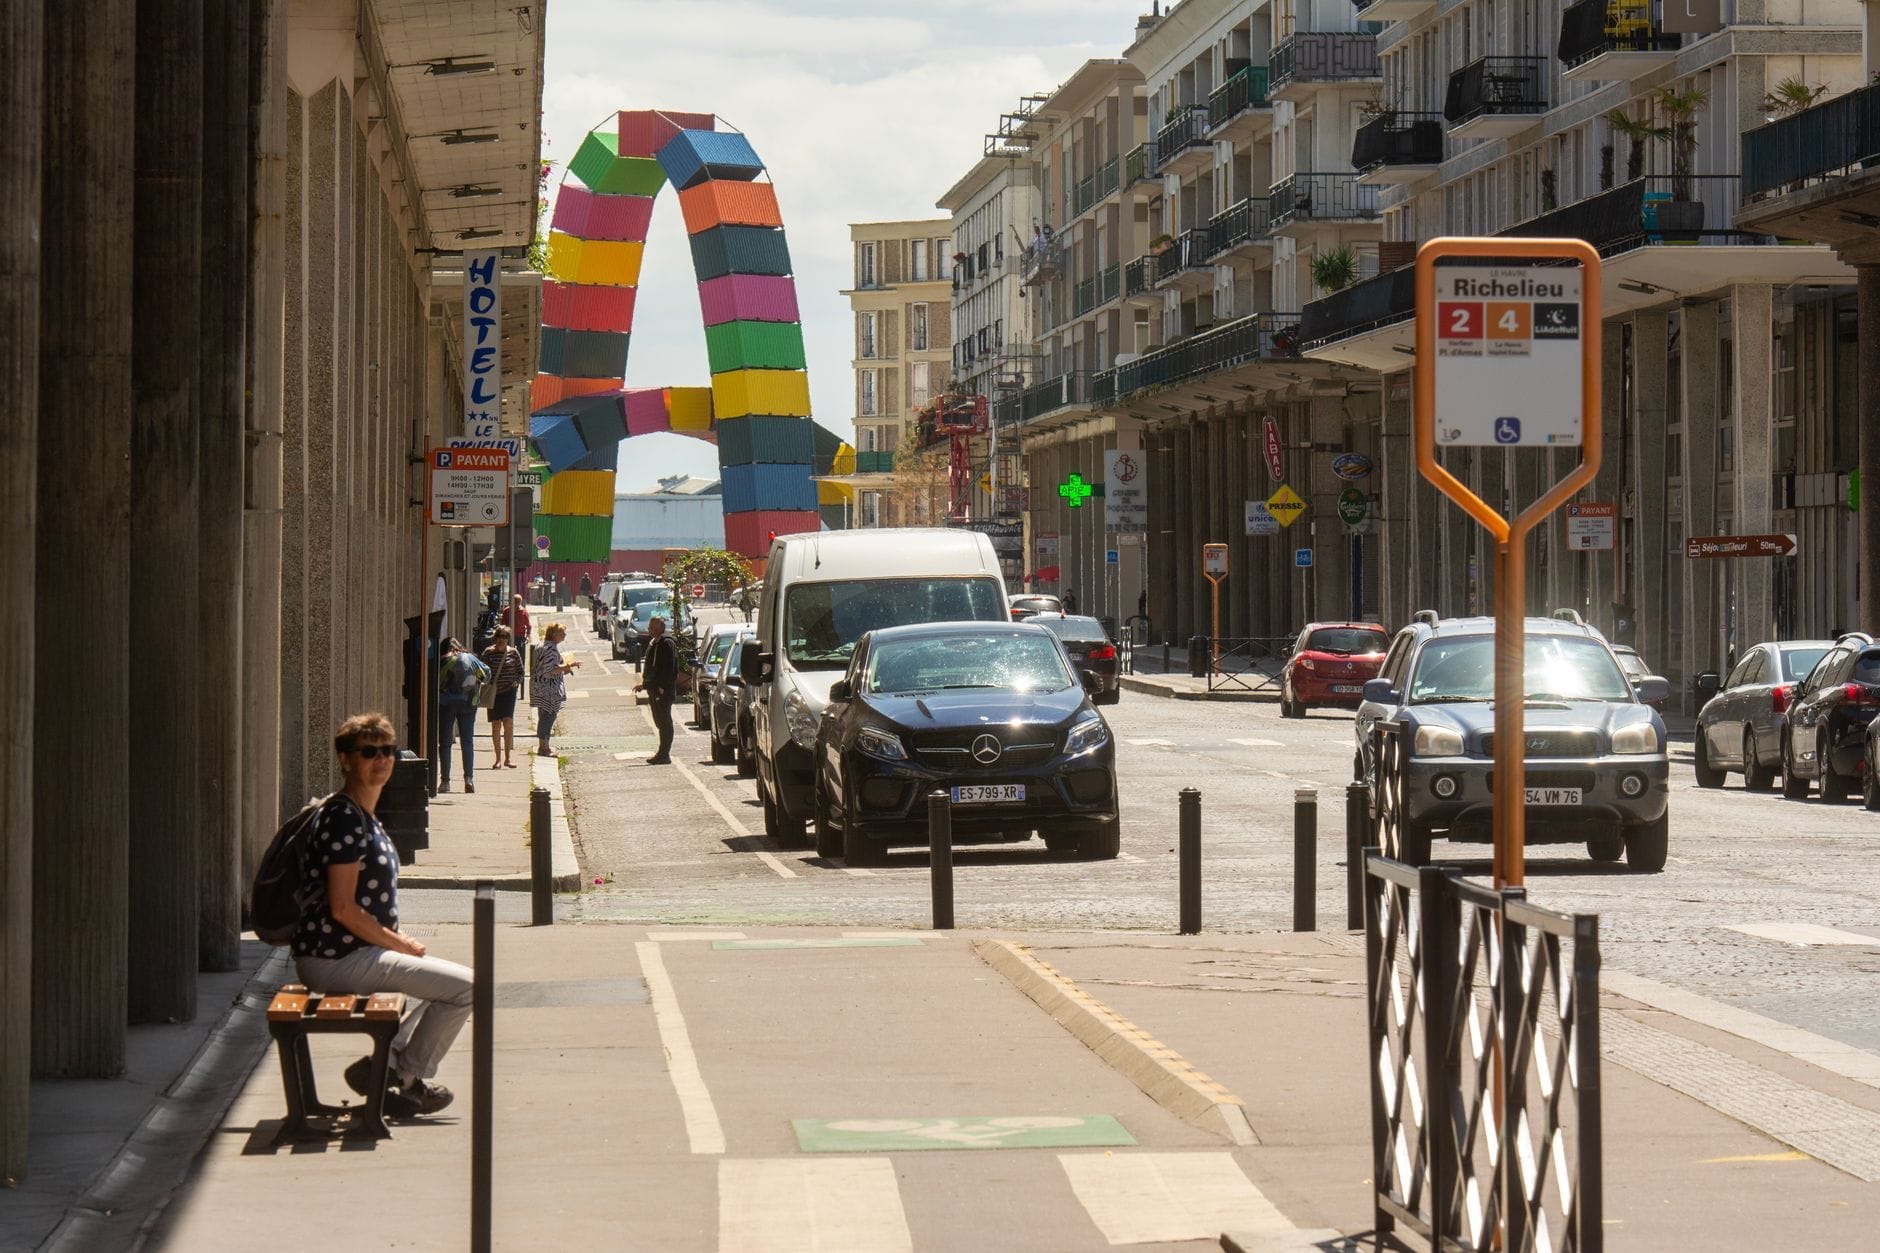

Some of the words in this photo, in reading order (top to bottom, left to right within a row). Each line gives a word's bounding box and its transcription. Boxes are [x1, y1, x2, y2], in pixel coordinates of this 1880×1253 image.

[1501, 270, 1527, 278] HAVRE
[1453, 278, 1564, 298] Richelieu
[1451, 308, 1471, 334] 2
[1498, 309, 1520, 334] 4
[469, 255, 497, 405] HOTEL
[474, 425, 493, 437] LE
[1267, 421, 1281, 477] TABAC
[456, 454, 507, 467] PAYANT
[1268, 502, 1304, 511] PRESSE
[1581, 506, 1612, 514] PAYANT
[1760, 541, 1776, 550] 50m
[960, 786, 1017, 800] ES-799-XR
[1523, 790, 1540, 803] 54
[1544, 790, 1560, 803] VM
[1563, 790, 1578, 803] 76
